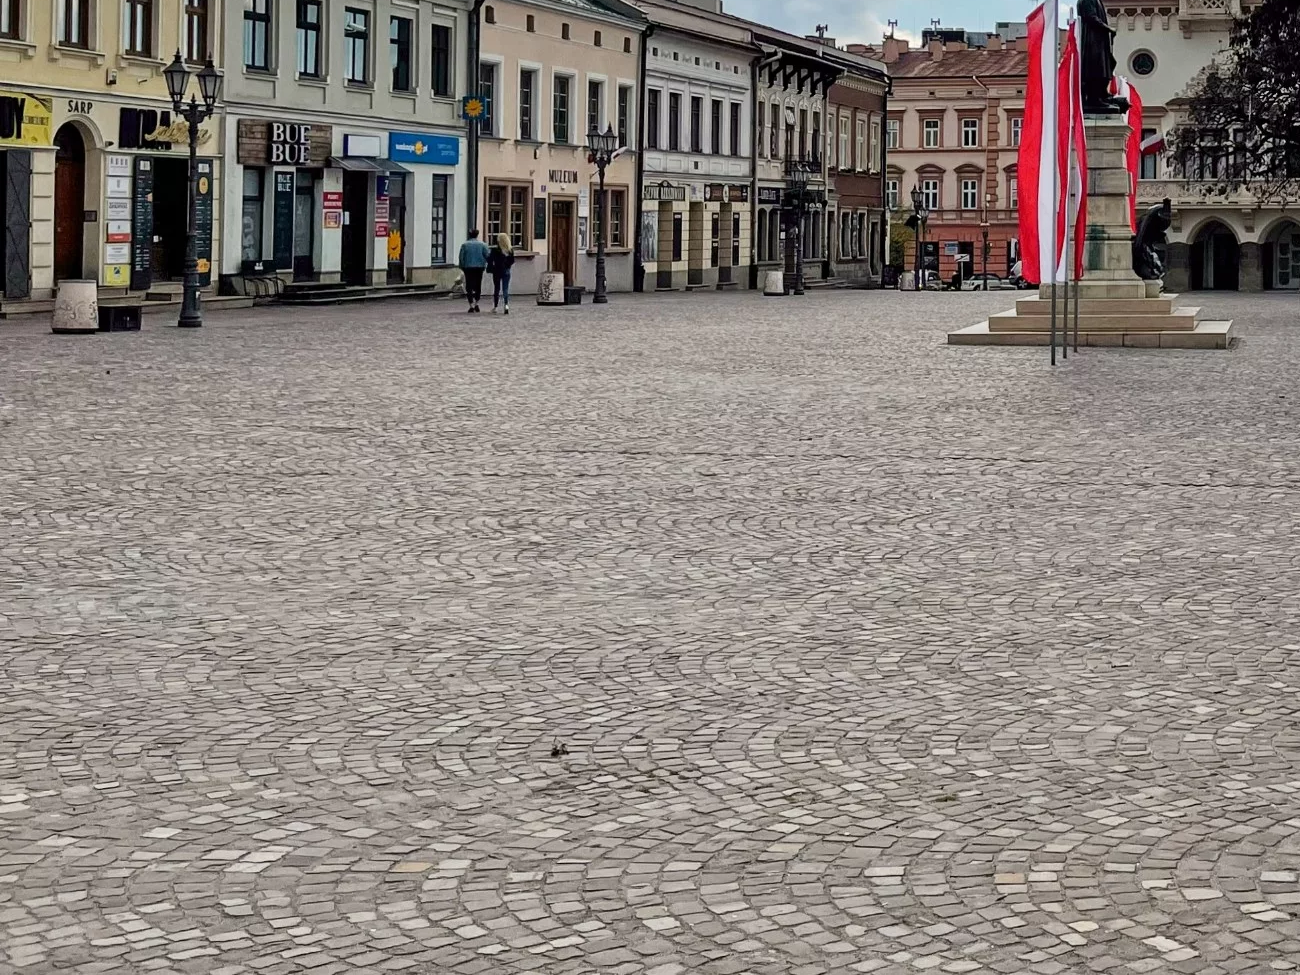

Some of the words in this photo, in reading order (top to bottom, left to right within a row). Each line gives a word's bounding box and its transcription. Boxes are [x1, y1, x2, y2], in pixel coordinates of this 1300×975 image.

[68, 100, 93, 115] SARP
[272, 122, 311, 144] BUE
[271, 143, 311, 163] BUE
[549, 169, 578, 184] MUZEUM
